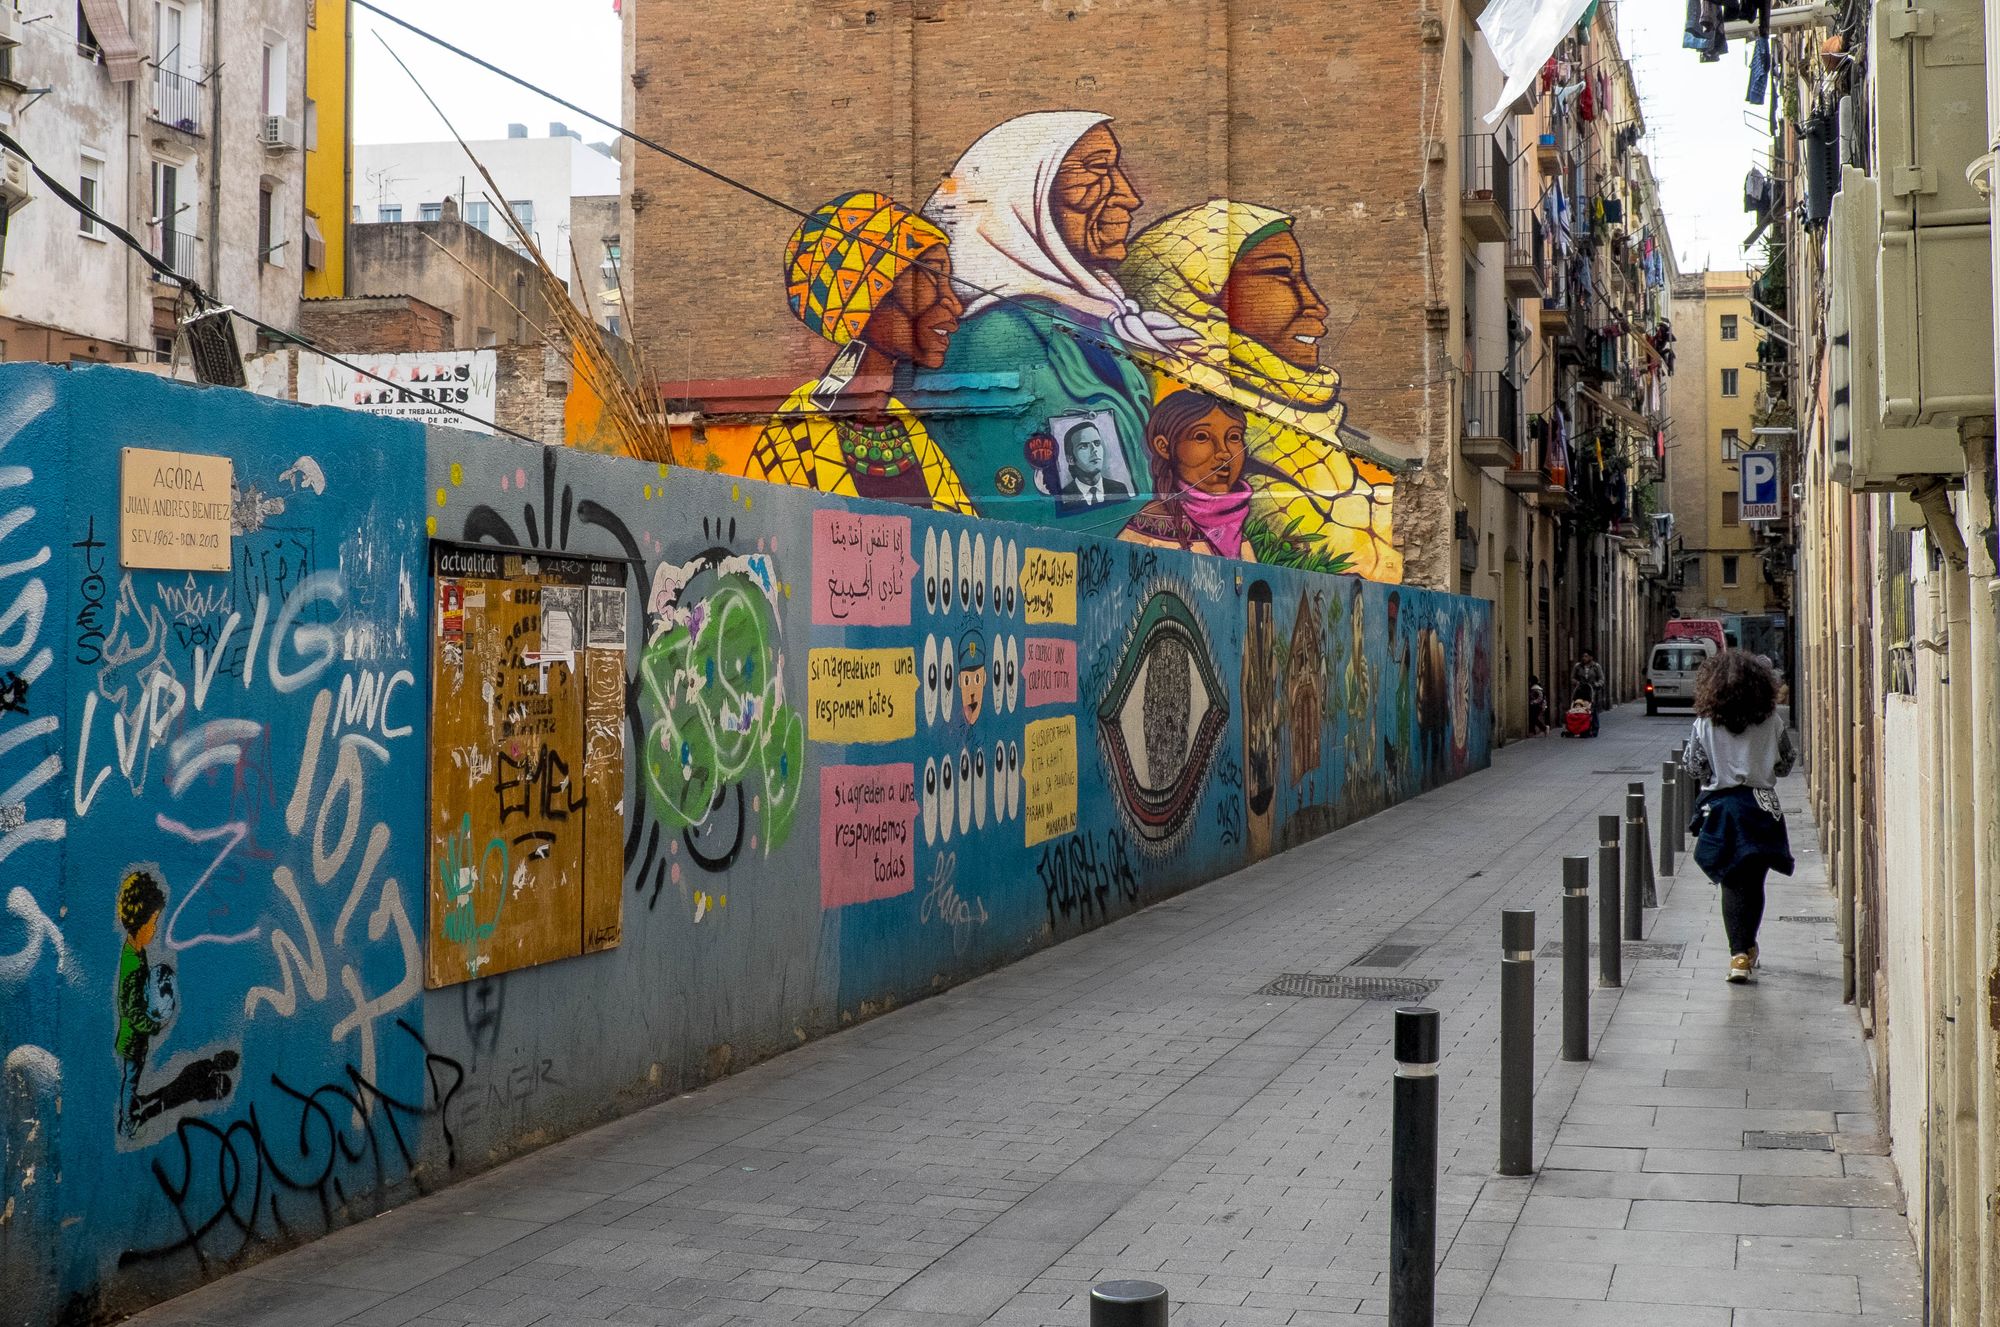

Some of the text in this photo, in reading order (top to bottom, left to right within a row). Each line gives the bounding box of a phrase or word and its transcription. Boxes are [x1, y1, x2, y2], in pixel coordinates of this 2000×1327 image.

[153, 467, 205, 491] AGORA
[1001, 474, 1017, 489] 43
[1745, 456, 1774, 501] P
[125, 495, 230, 521] JUAN ANDRES BENITEZ
[1743, 504, 1778, 518] AURORA
[441, 551, 496, 573] actualitat
[591, 561, 607, 573] cada
[811, 657, 820, 681] si
[894, 655, 913, 677] una
[815, 687, 894, 730] responem totes
[888, 784, 895, 801] a
[900, 782, 915, 803] una
[835, 813, 907, 859] respondemos
[873, 847, 906, 882] todas
